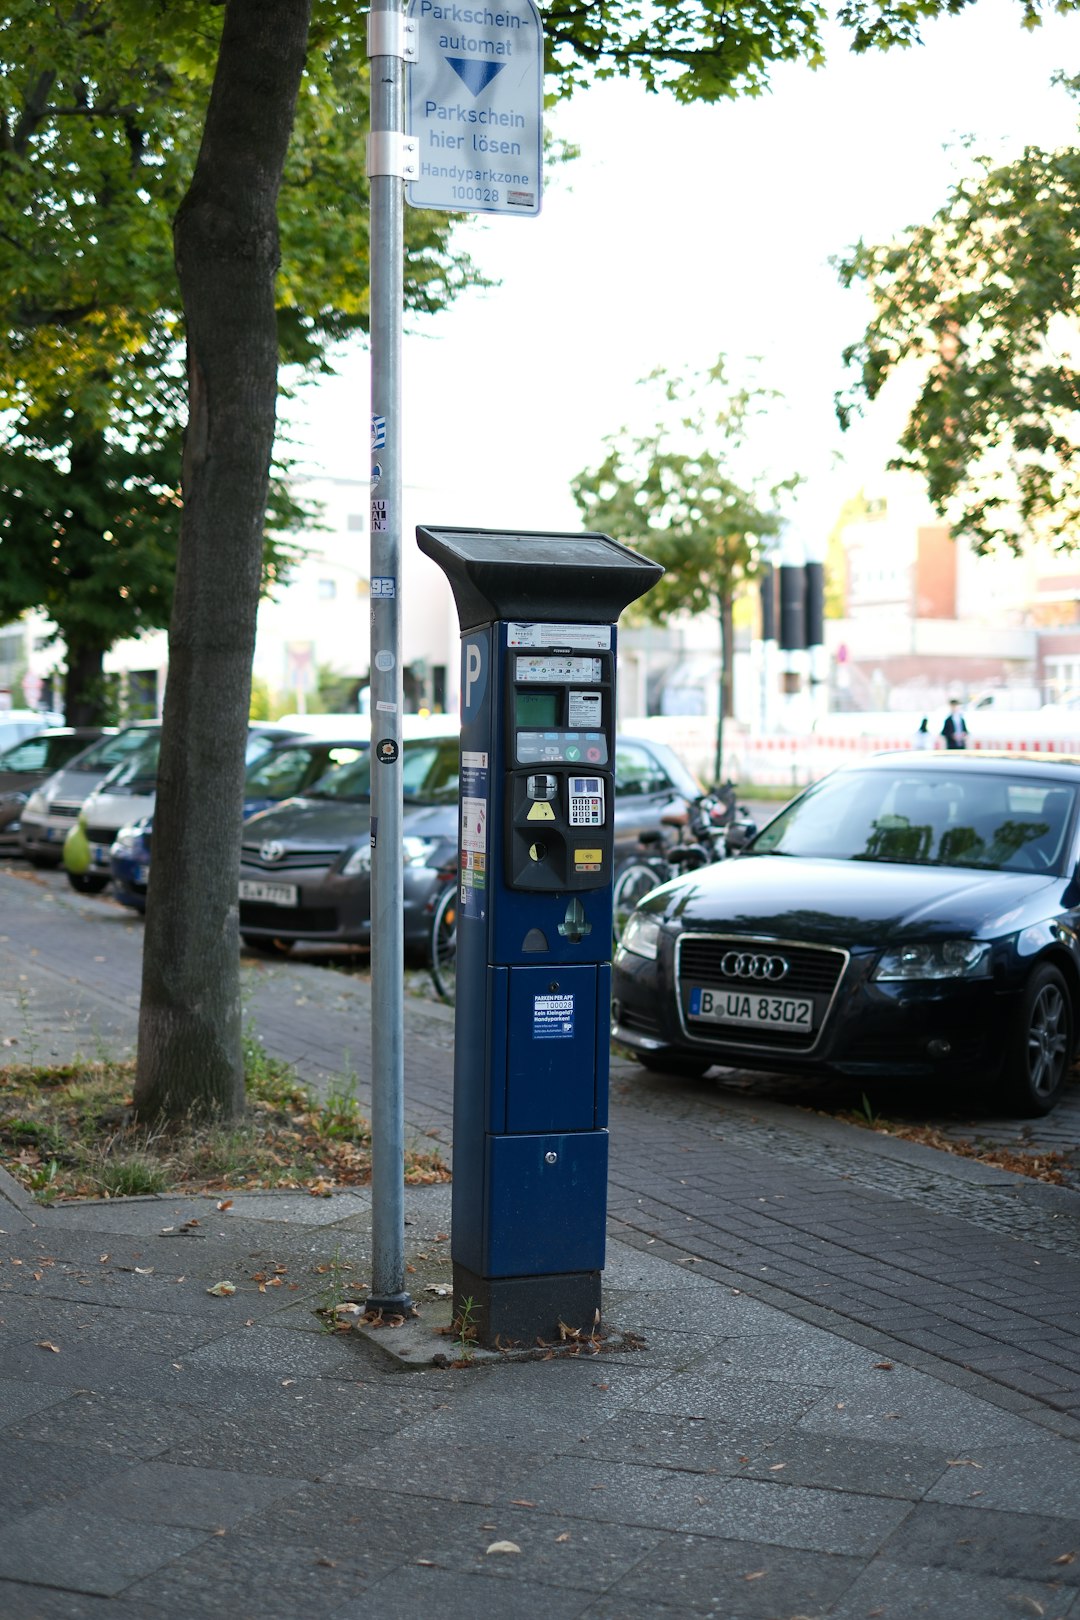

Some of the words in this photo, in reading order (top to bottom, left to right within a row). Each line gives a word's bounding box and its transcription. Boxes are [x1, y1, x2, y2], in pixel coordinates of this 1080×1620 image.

[420, 0, 529, 29] Parkschein-
[439, 35, 512, 56] automat
[425, 101, 525, 128] Parkschein
[429, 129, 465, 150] hier
[473, 134, 521, 155] lösen
[421, 162, 529, 185] Handyparkzone
[451, 186, 499, 202] 100028
[466, 644, 481, 707] P
[702, 992, 714, 1013] B
[727, 995, 751, 1018] UA
[757, 999, 810, 1024] 8302
